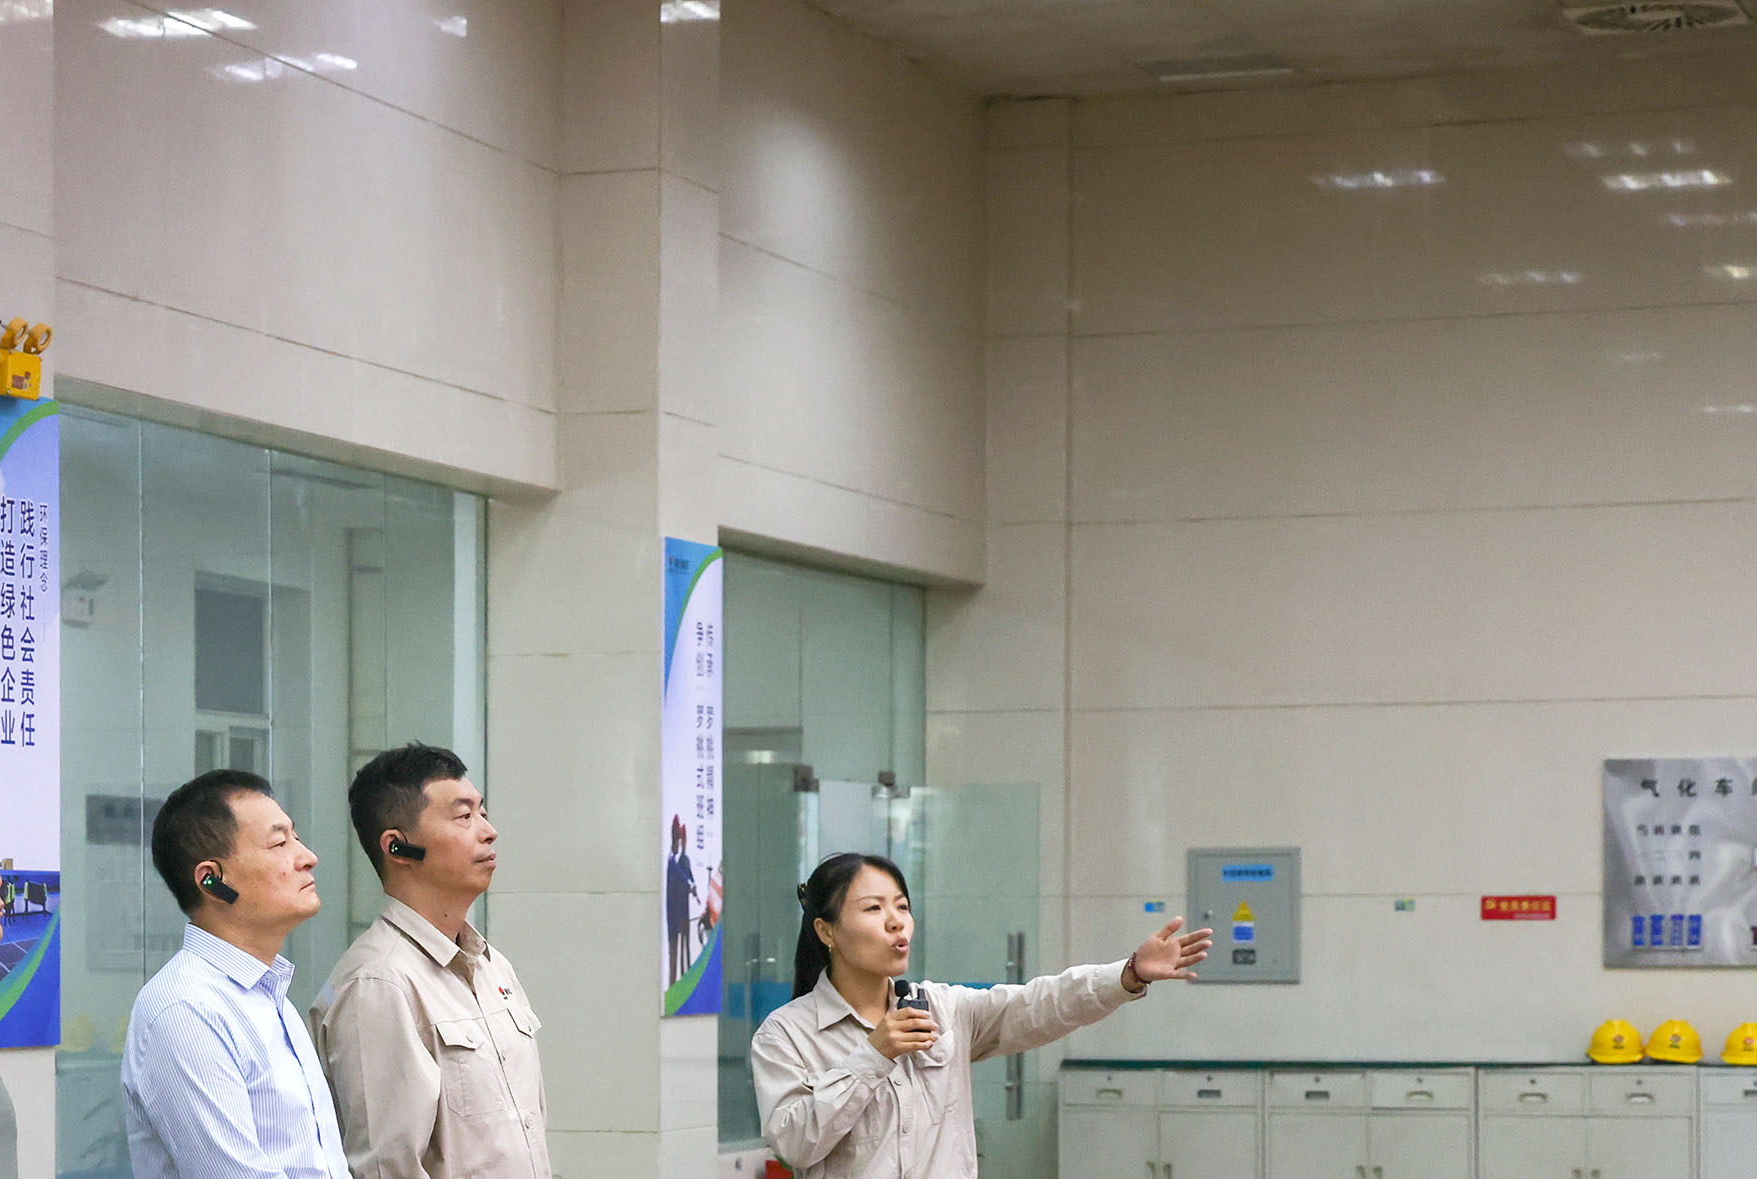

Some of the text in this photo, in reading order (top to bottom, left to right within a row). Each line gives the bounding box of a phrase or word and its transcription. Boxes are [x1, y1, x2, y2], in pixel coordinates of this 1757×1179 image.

[0, 496, 16, 745] 打造绿色企业
[20, 500, 35, 748] 践行社会责任
